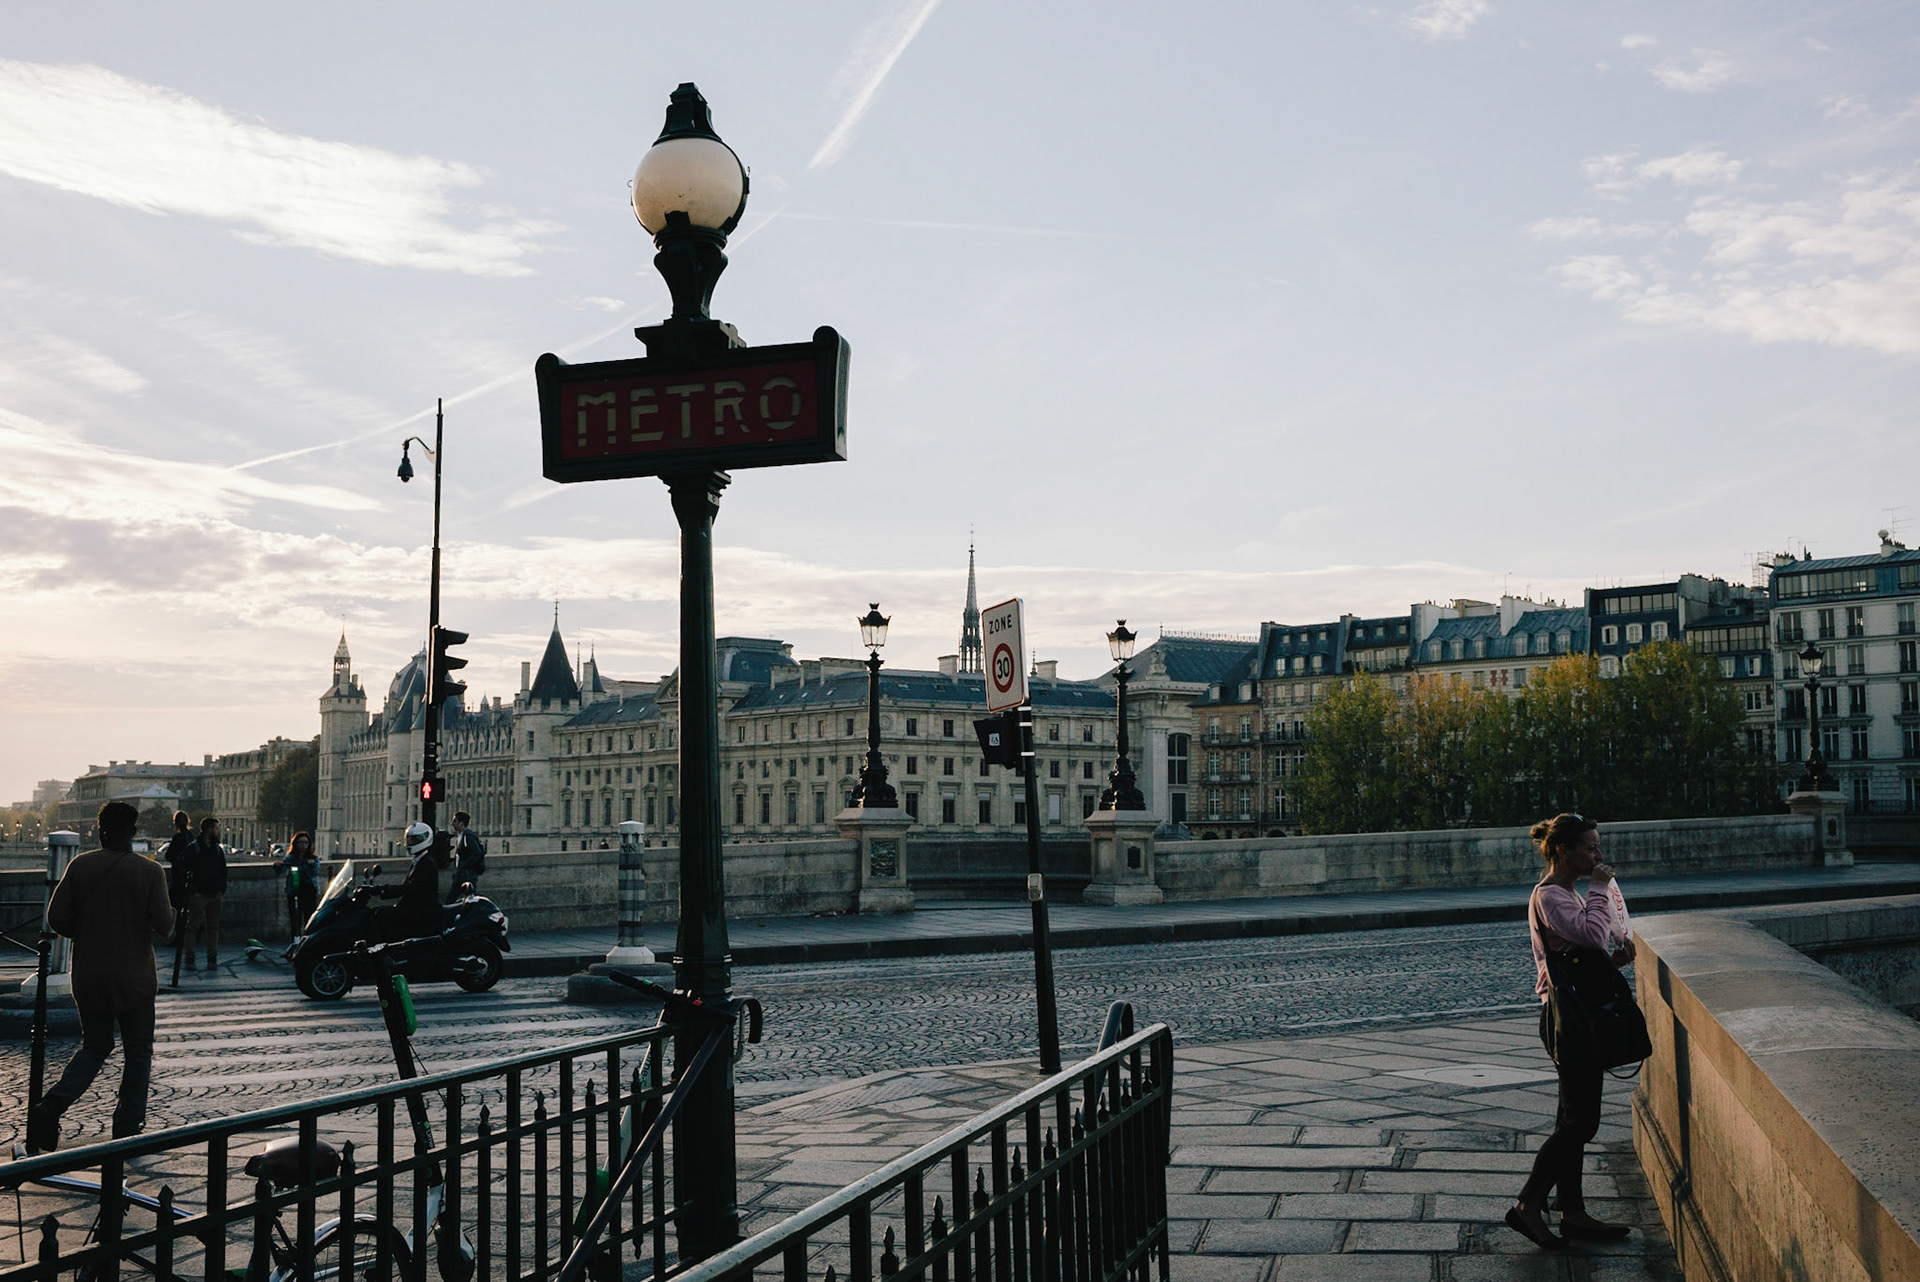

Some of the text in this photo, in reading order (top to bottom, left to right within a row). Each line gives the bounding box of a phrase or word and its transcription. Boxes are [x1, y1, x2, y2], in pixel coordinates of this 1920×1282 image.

[577, 375, 802, 448] METRO
[989, 614, 1012, 634] ZONE
[997, 657, 1009, 679] 30
